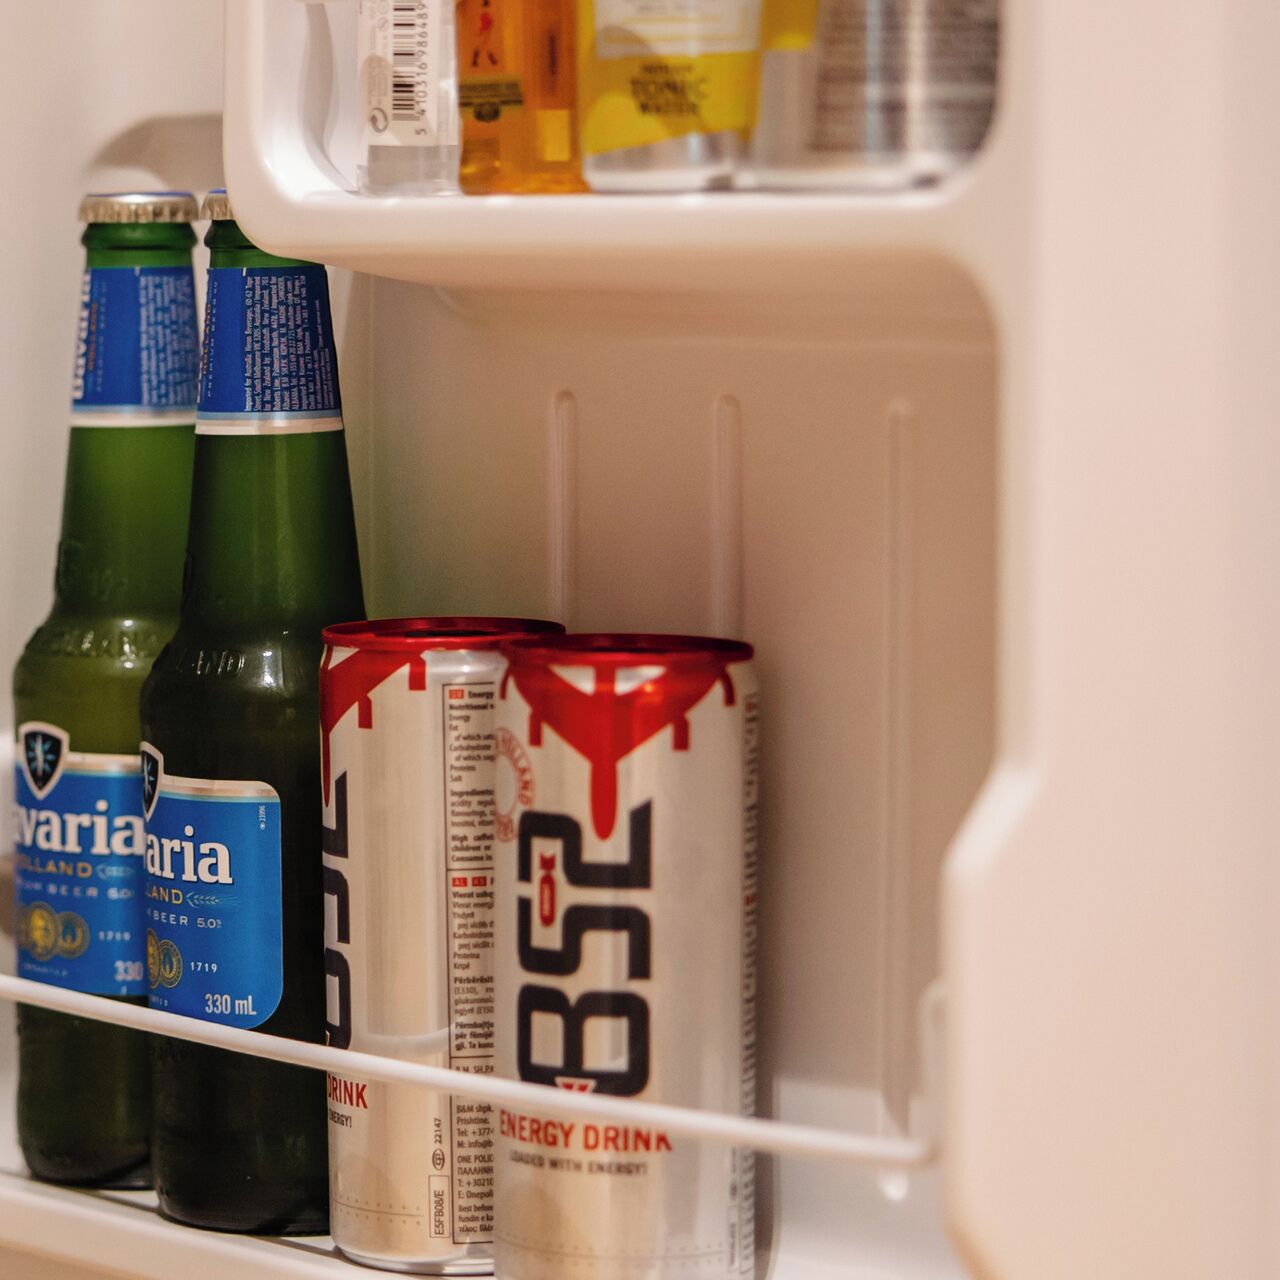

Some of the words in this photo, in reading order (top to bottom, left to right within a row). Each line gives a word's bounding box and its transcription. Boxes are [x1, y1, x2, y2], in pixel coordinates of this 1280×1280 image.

[145, 825, 233, 884] aria
[153, 911, 188, 926] BEER
[190, 961, 218, 974] 1719
[205, 994, 231, 1014] 330
[235, 995, 257, 1015] mL
[500, 1108, 575, 1148] ENERGY
[583, 1125, 673, 1152] DRINK
[458, 1155, 472, 1163] ONE
